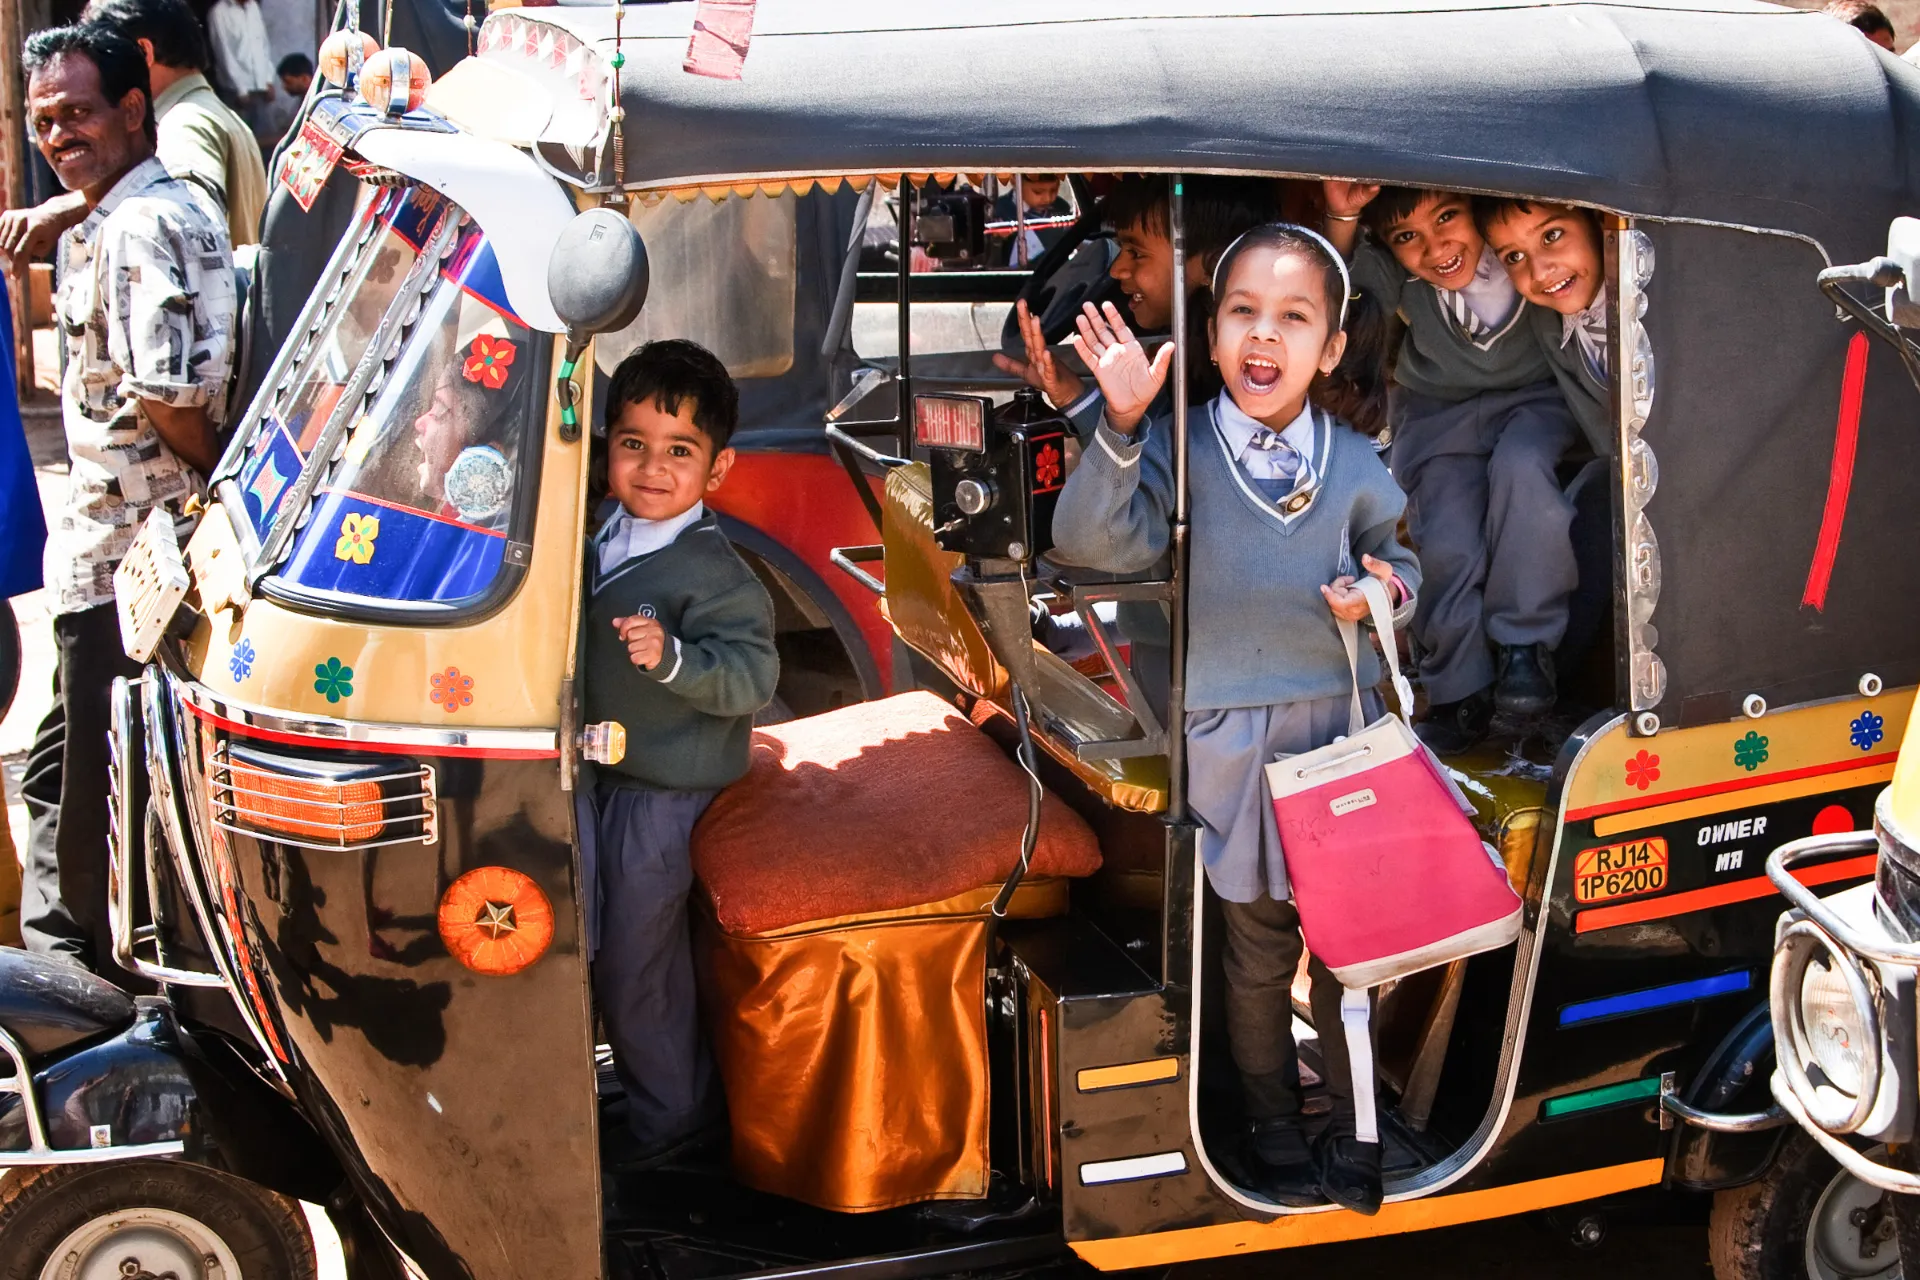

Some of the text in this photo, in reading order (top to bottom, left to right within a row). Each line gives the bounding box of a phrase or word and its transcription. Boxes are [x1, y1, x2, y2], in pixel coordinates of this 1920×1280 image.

[1697, 816, 1768, 846] OWNER
[1597, 842, 1650, 872] RJ14
[1580, 866, 1663, 899] 1P6200
